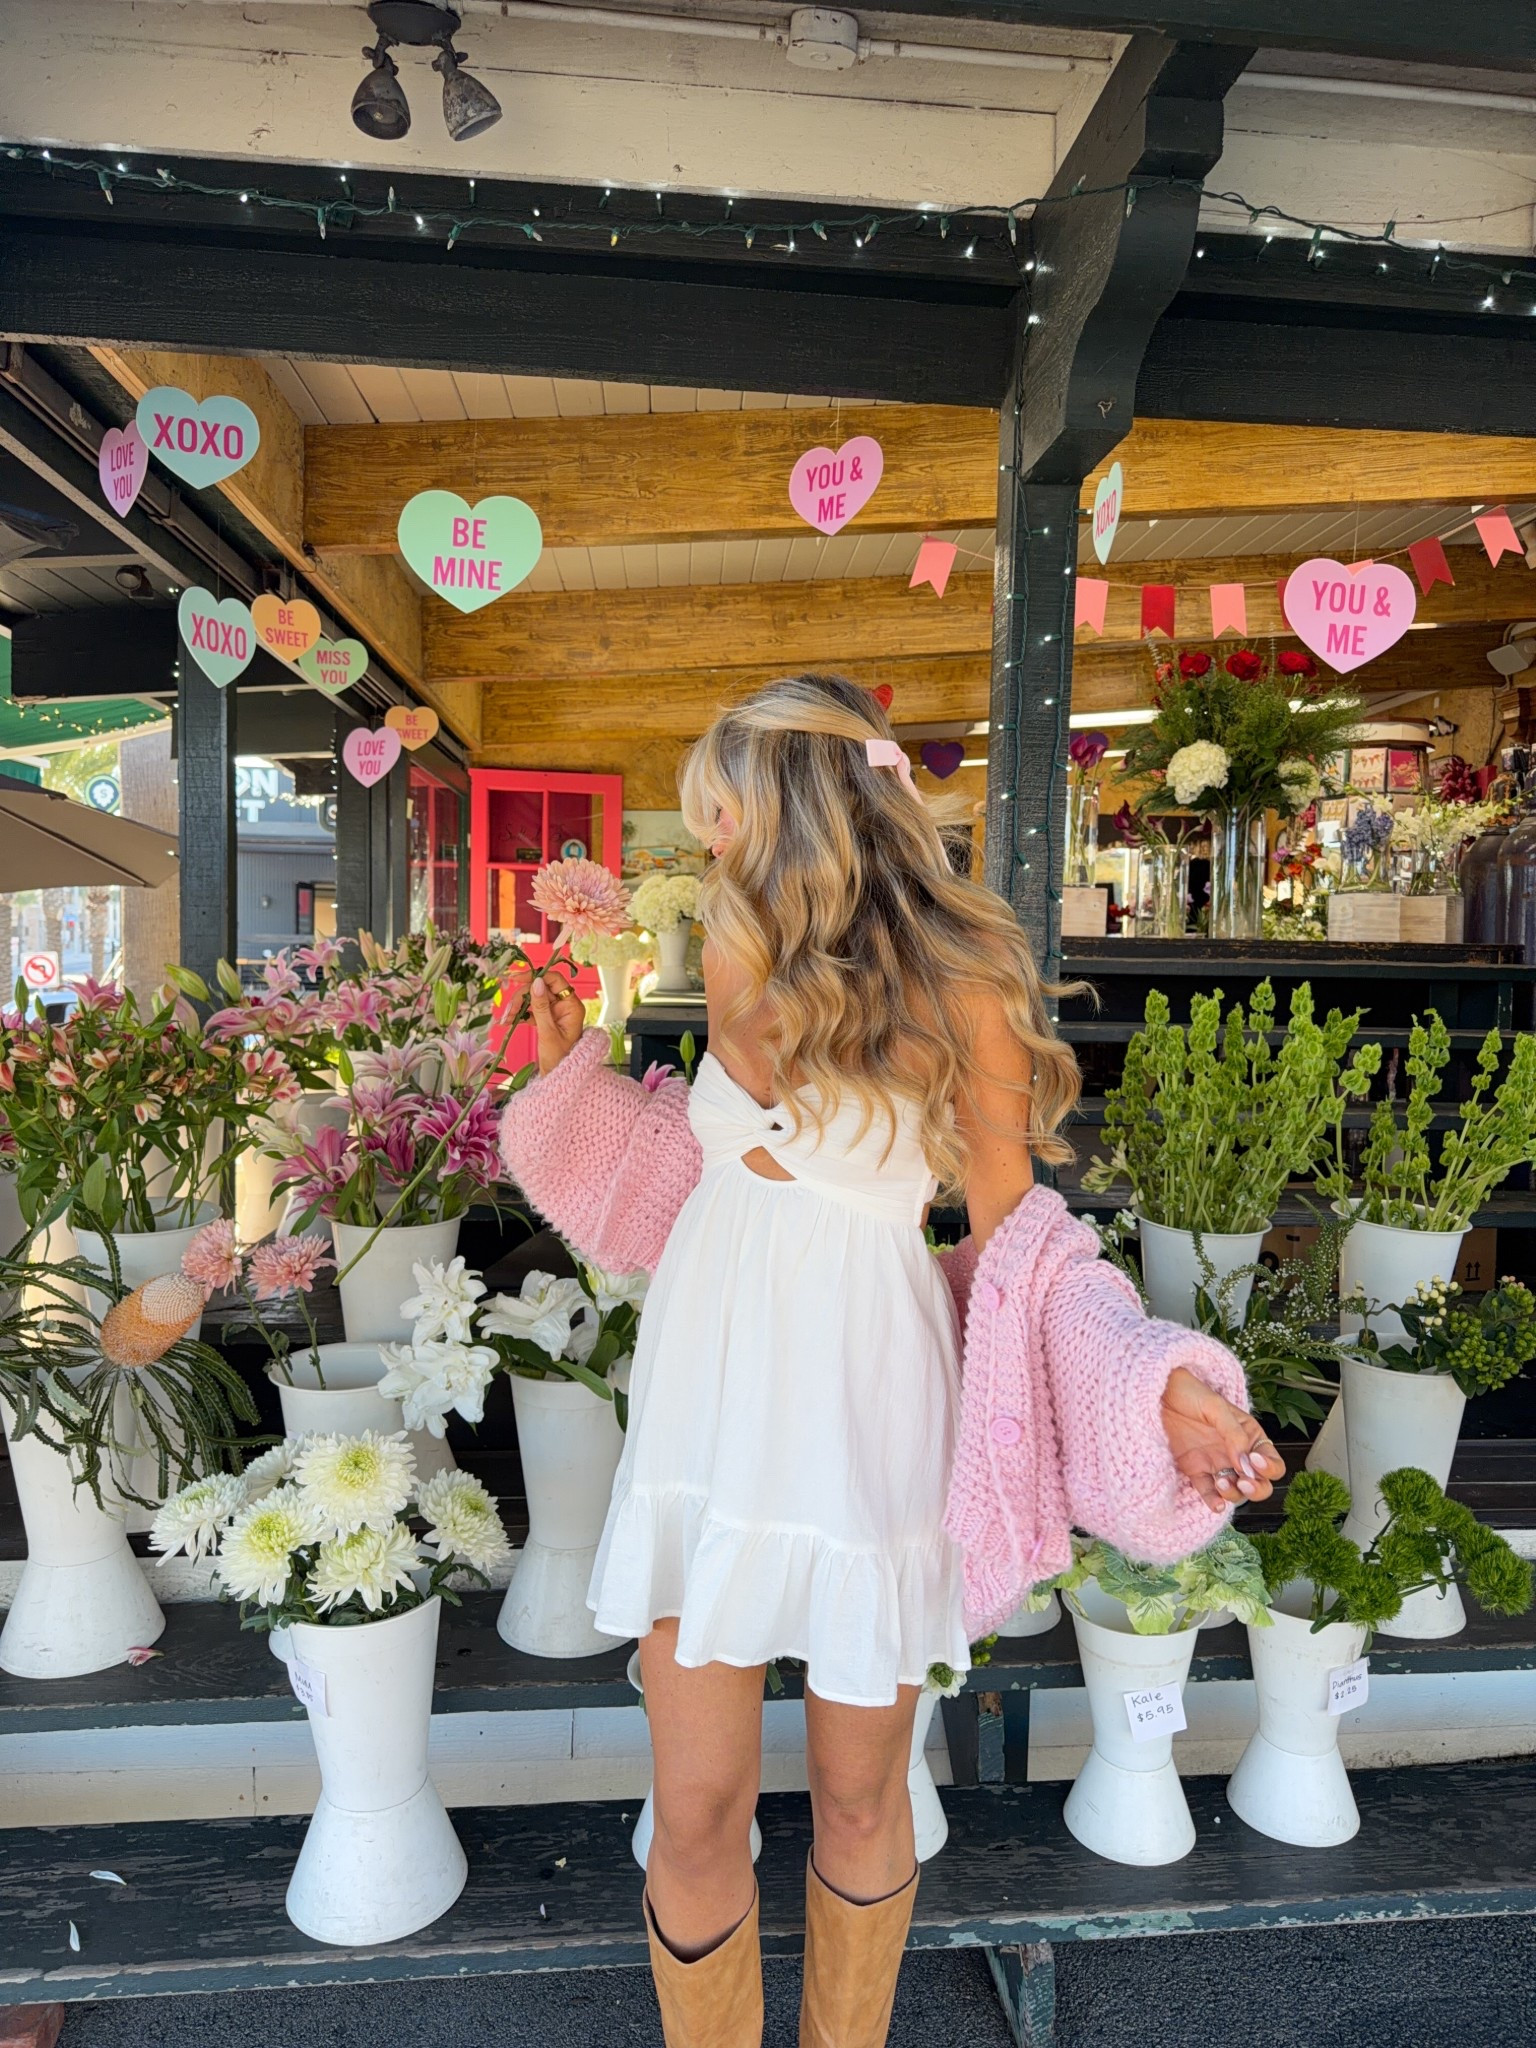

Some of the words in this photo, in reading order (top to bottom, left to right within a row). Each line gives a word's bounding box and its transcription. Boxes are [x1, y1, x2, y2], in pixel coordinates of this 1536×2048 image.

[153, 412, 244, 460] XOXO
[110, 441, 135, 471] LOVE
[805, 457, 845, 490] YOU
[849, 454, 864, 483] &
[113, 473, 133, 501] YOU
[816, 492, 848, 522] ME
[1095, 489, 1117, 541] XOXO
[452, 517, 488, 550] BE
[432, 556, 503, 592] MINE
[1310, 580, 1367, 615] YOU
[1371, 586, 1391, 618] &
[278, 608, 295, 627] BE
[191, 612, 247, 661] XOXO
[265, 627, 309, 649] SWEET
[1326, 623, 1368, 656] ME
[316, 649, 351, 666] MISS
[320, 669, 348, 686] YOU
[405, 714, 418, 727] BE
[356, 739, 386, 757] LOVE
[359, 760, 382, 776] YOU
[1130, 1692, 1164, 1708] Kale
[1136, 1703, 1175, 1723] $5.95
